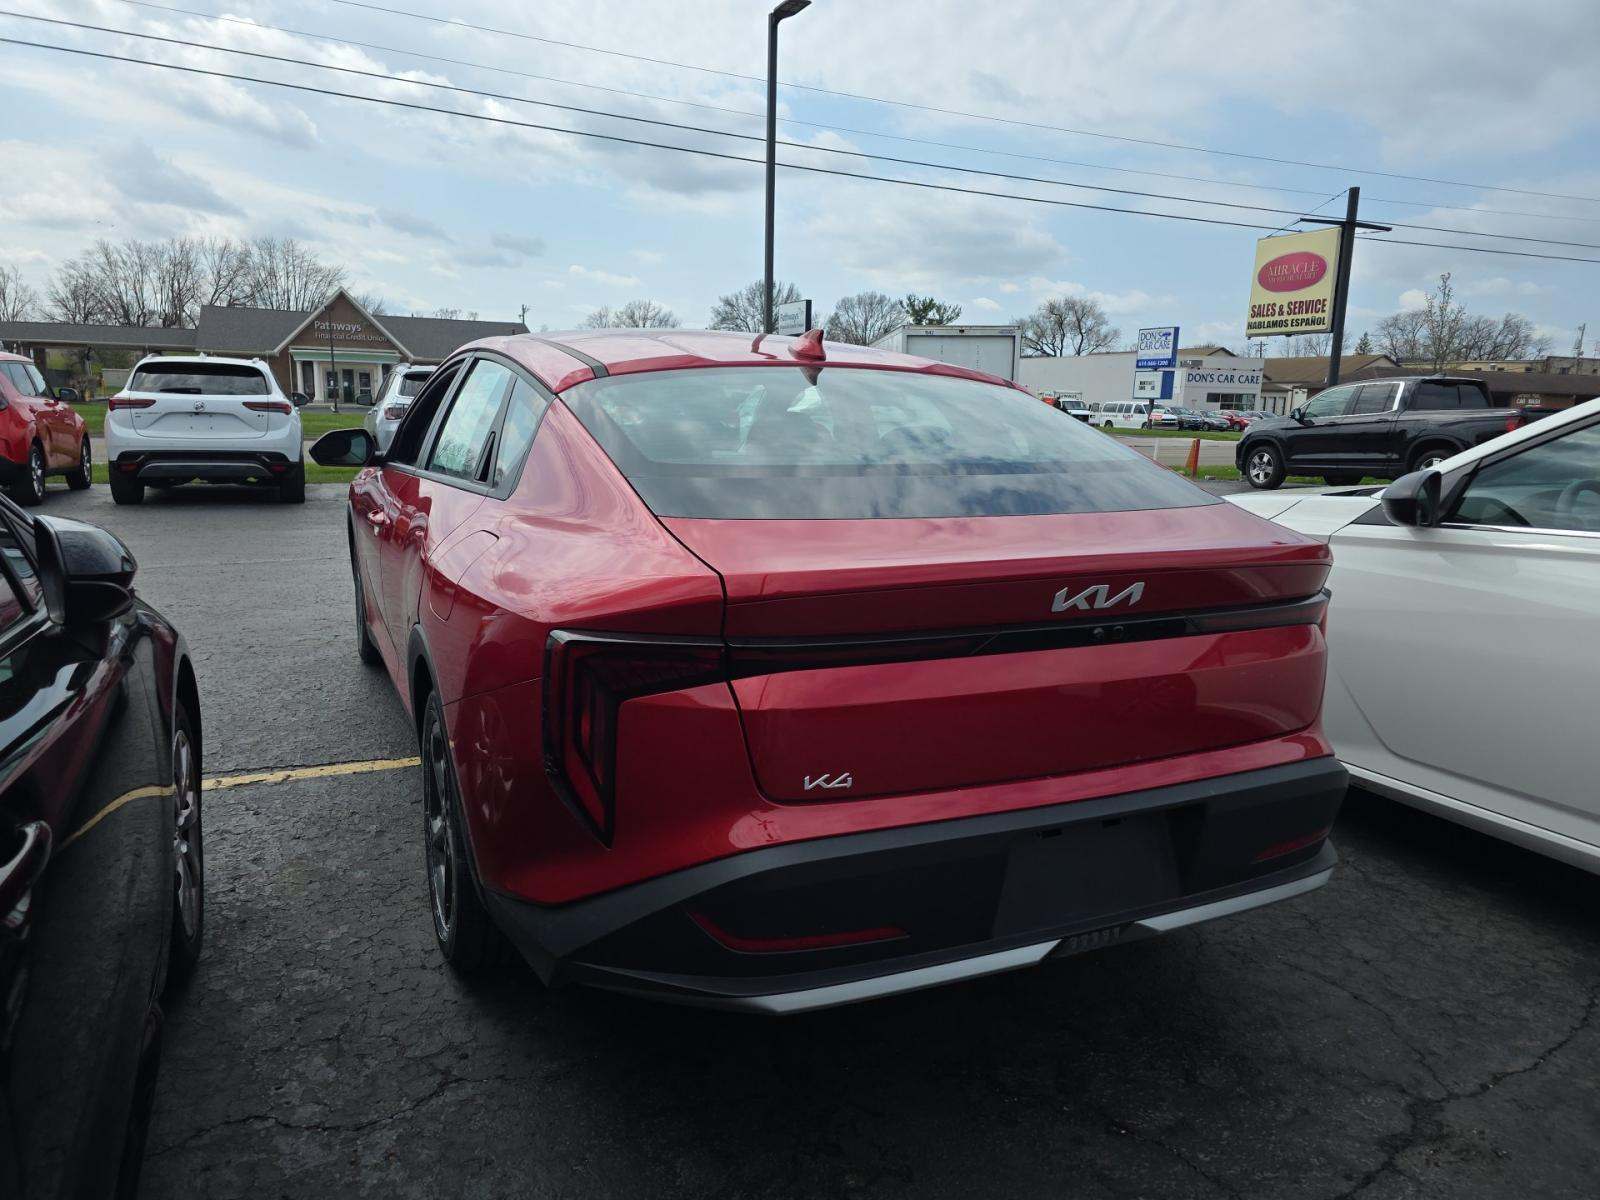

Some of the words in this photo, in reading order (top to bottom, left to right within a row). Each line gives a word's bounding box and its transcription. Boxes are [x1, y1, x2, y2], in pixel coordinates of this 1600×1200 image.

[1269, 262, 1319, 275] MIRACLE
[1251, 303, 1276, 318] SALES
[1278, 304, 1284, 316] &
[1287, 299, 1327, 315] SERVICE
[314, 321, 361, 332] Pathways
[1247, 319, 1289, 329] HABLAMOS
[1291, 316, 1326, 327] ESPAÑOL
[1140, 331, 1162, 341] DON'S
[1140, 342, 1153, 350] CAR
[1154, 341, 1171, 349] CARE
[1187, 372, 1215, 383] DON'S
[1217, 374, 1235, 384] CAR
[1238, 375, 1260, 384] CARE
[804, 772, 852, 790] K4
